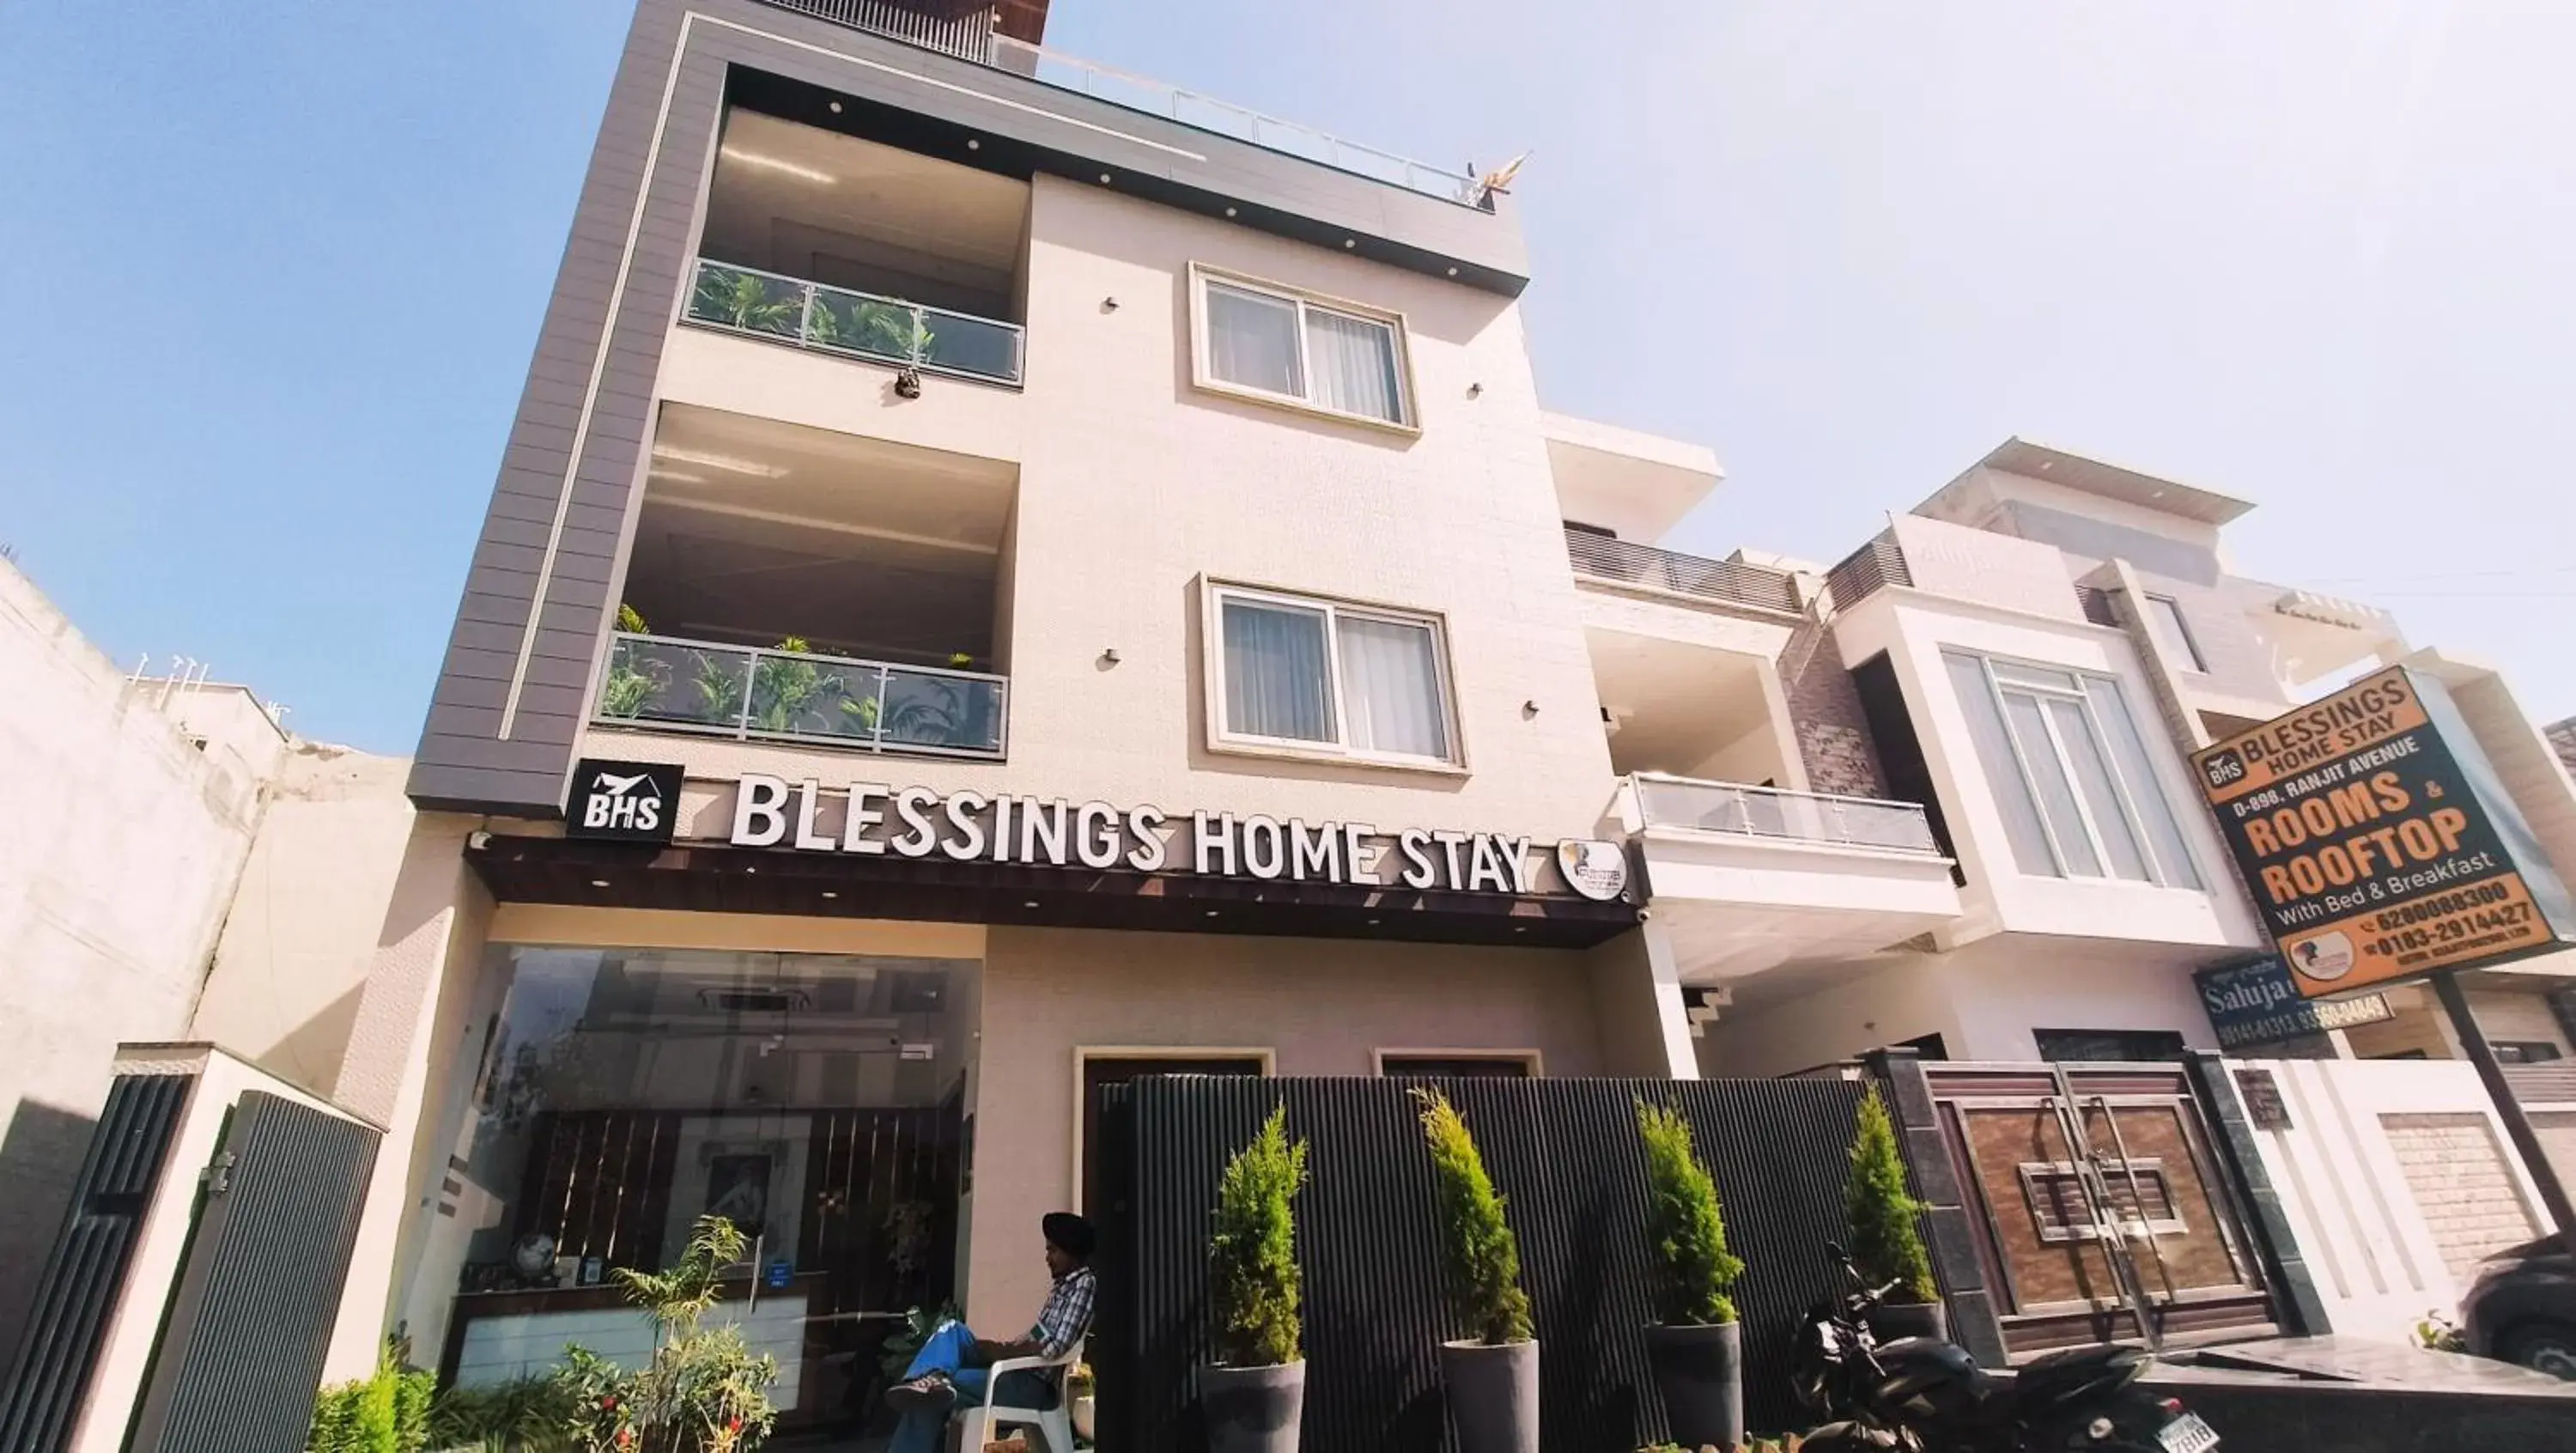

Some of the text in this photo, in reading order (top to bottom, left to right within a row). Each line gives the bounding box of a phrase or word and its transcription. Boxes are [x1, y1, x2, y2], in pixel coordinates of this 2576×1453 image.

[2240, 679, 2407, 763] BLESSINGS
[2266, 711, 2397, 776] HOME STAY
[2210, 762, 2242, 785] BHS
[2286, 763, 2346, 799] RANJIT
[2349, 735, 2421, 775] AVENUE
[583, 793, 661, 832] BHS
[731, 772, 1531, 894] BLESSINGS HOME STAY
[2243, 771, 2445, 857] ROOMS &
[2260, 807, 2466, 904] ROOFTOP
[2276, 851, 2495, 927] With Bed & Breakfast
[2376, 902, 2532, 957] 0183-2914427
[2205, 976, 2288, 1014] Saluja
